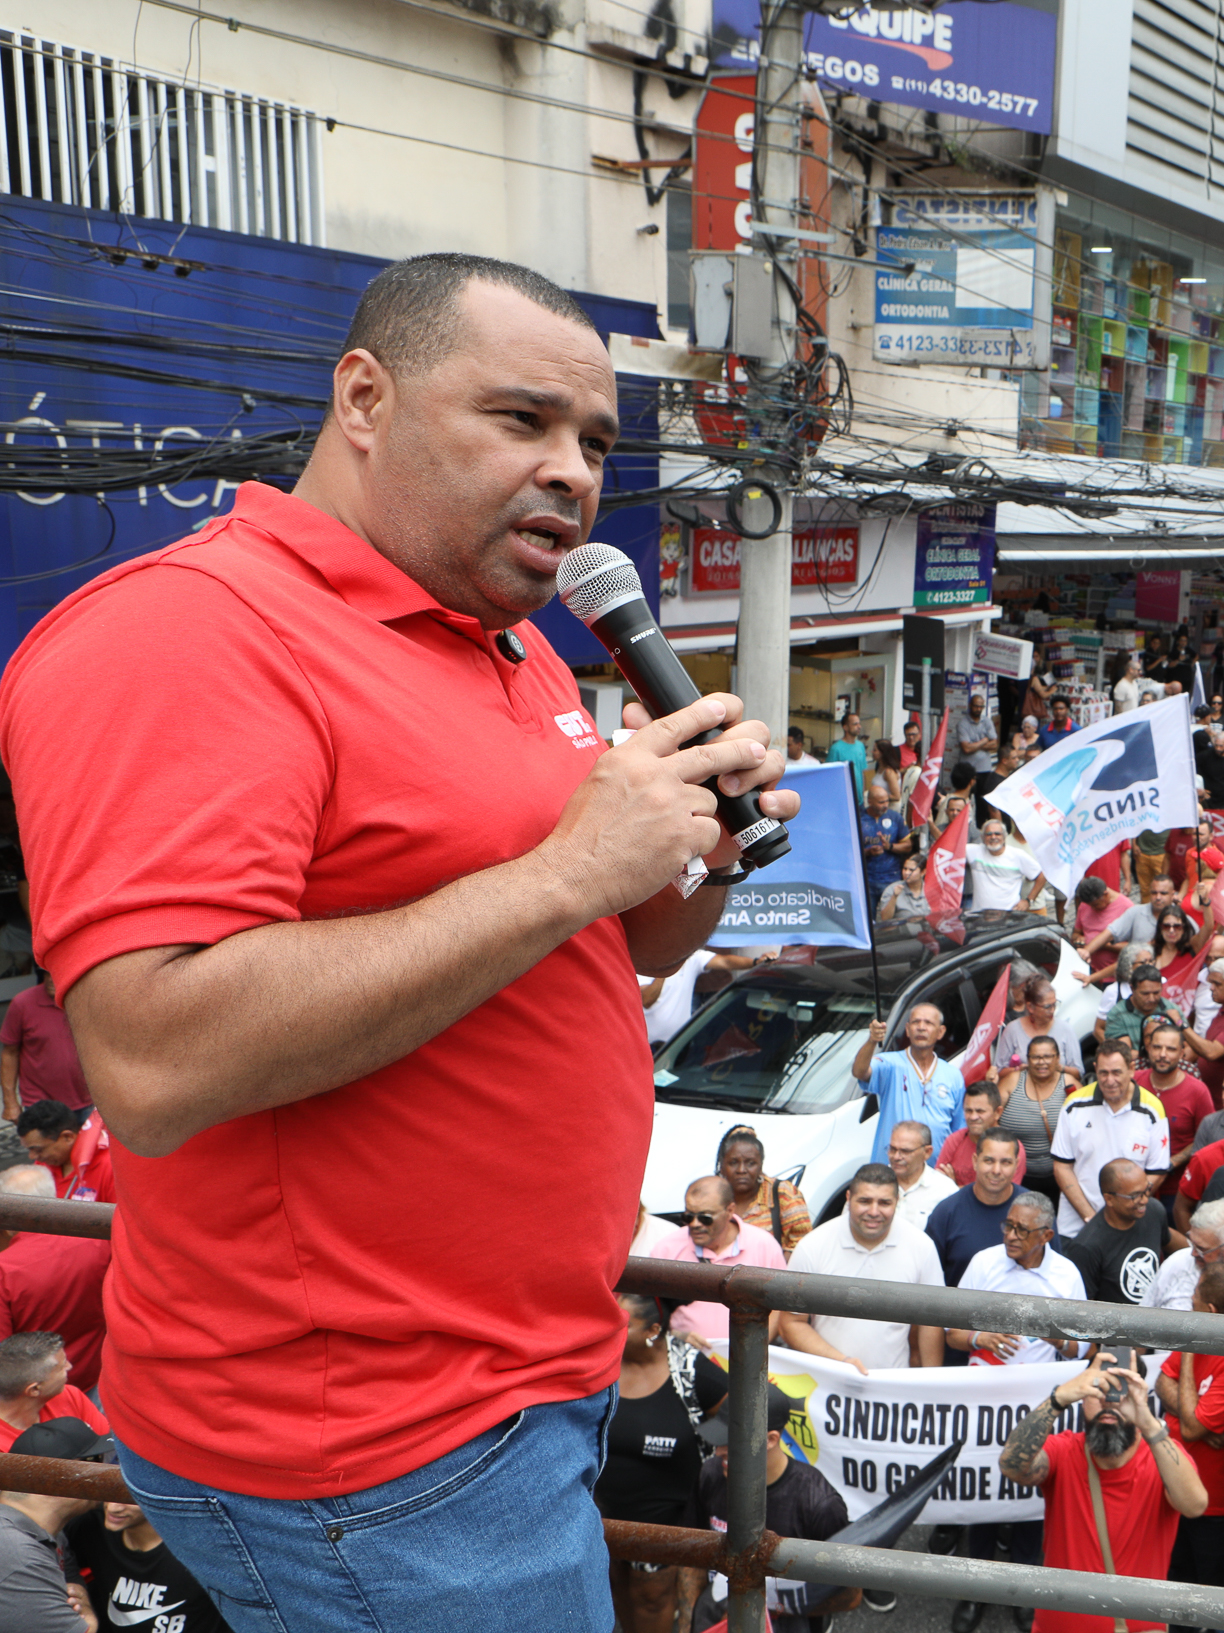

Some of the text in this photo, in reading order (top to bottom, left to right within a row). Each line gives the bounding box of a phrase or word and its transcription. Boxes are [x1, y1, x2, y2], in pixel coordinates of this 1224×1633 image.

[928, 77, 1038, 118] 4330-2577
[877, 274, 954, 292] CLÍNICA GERAL
[881, 303, 950, 318] ORTODONTIA
[792, 538, 855, 566] LIANÇAS
[925, 566, 979, 582] ORTODONTIA
[630, 627, 657, 644] SHURE
[741, 818, 775, 845] 5061611
[1132, 1143, 1148, 1154] PT
[825, 1393, 968, 1446] SINDICATO
[976, 1405, 1031, 1447] DOS
[842, 1456, 877, 1494] DO
[885, 1461, 991, 1502] GRNDE
[112, 1577, 167, 1608] NIKE
[153, 1614, 187, 1633] SB
